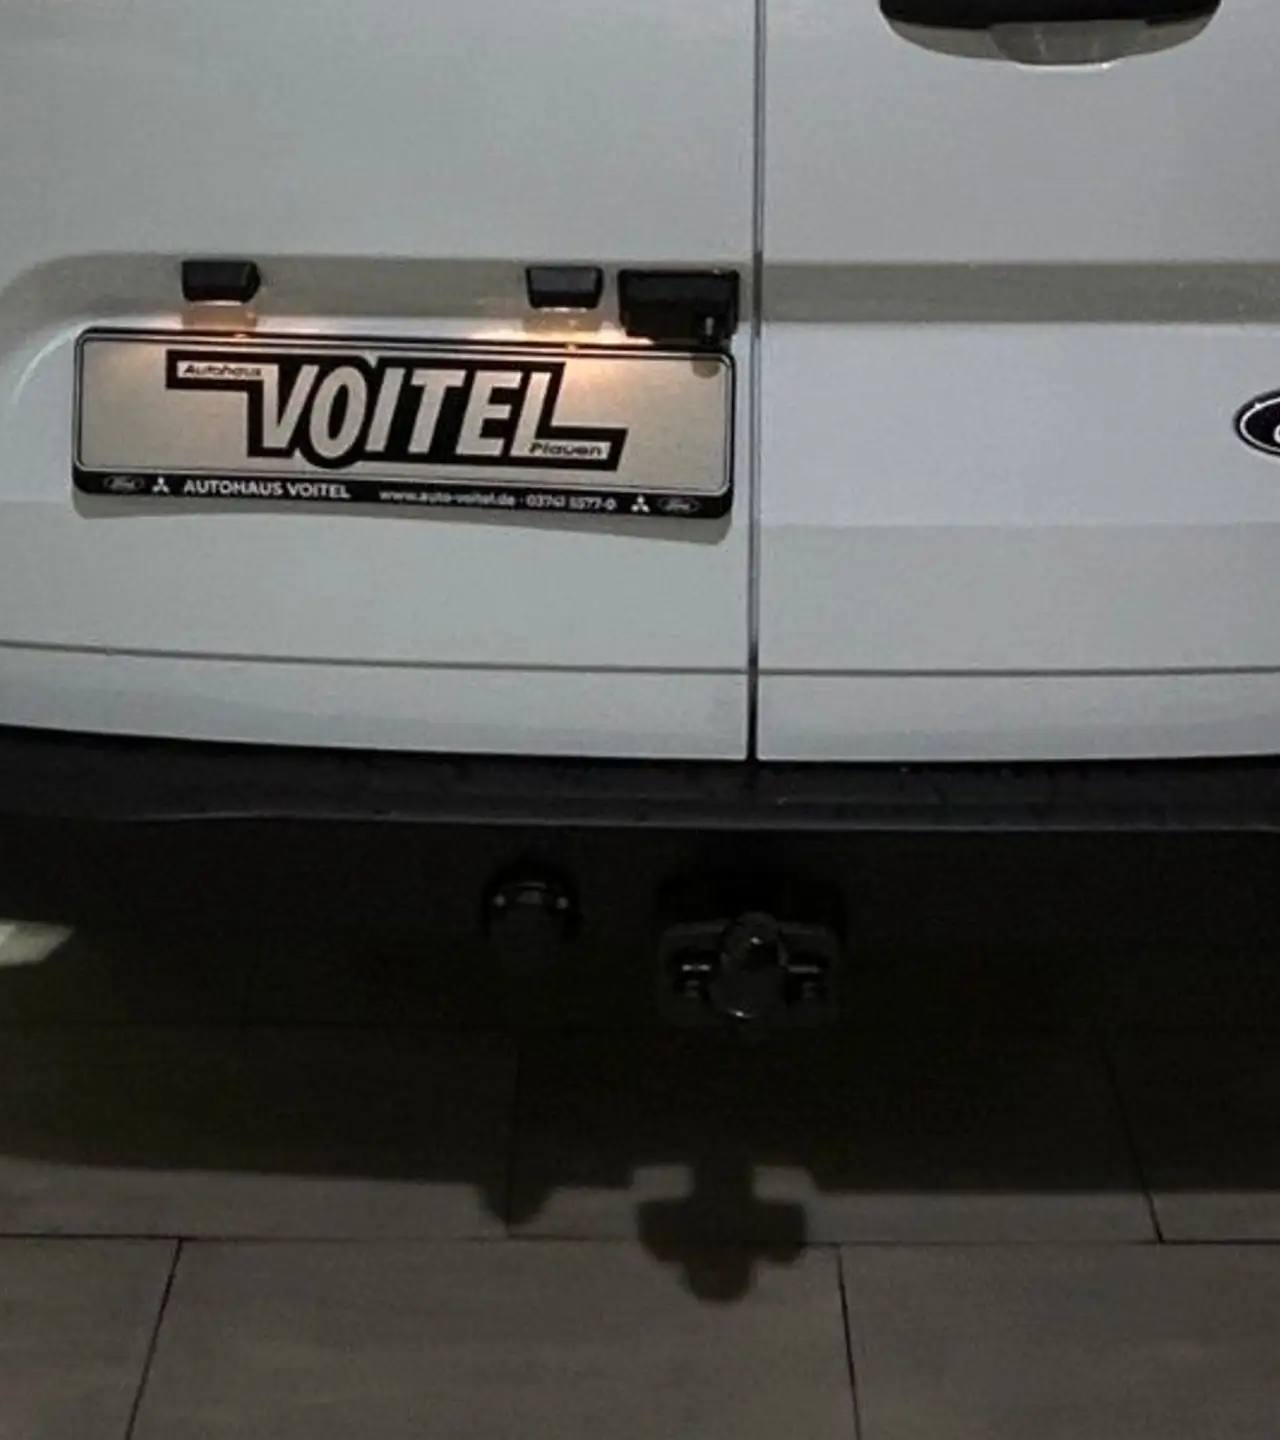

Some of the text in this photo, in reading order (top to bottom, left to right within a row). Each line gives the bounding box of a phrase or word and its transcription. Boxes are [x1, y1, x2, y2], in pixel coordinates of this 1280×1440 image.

[183, 363, 263, 379] Autohaus
[262, 362, 554, 460] VOITEL
[529, 441, 603, 458] Plauen
[183, 480, 352, 500] AUTOHAUS VOITEL
